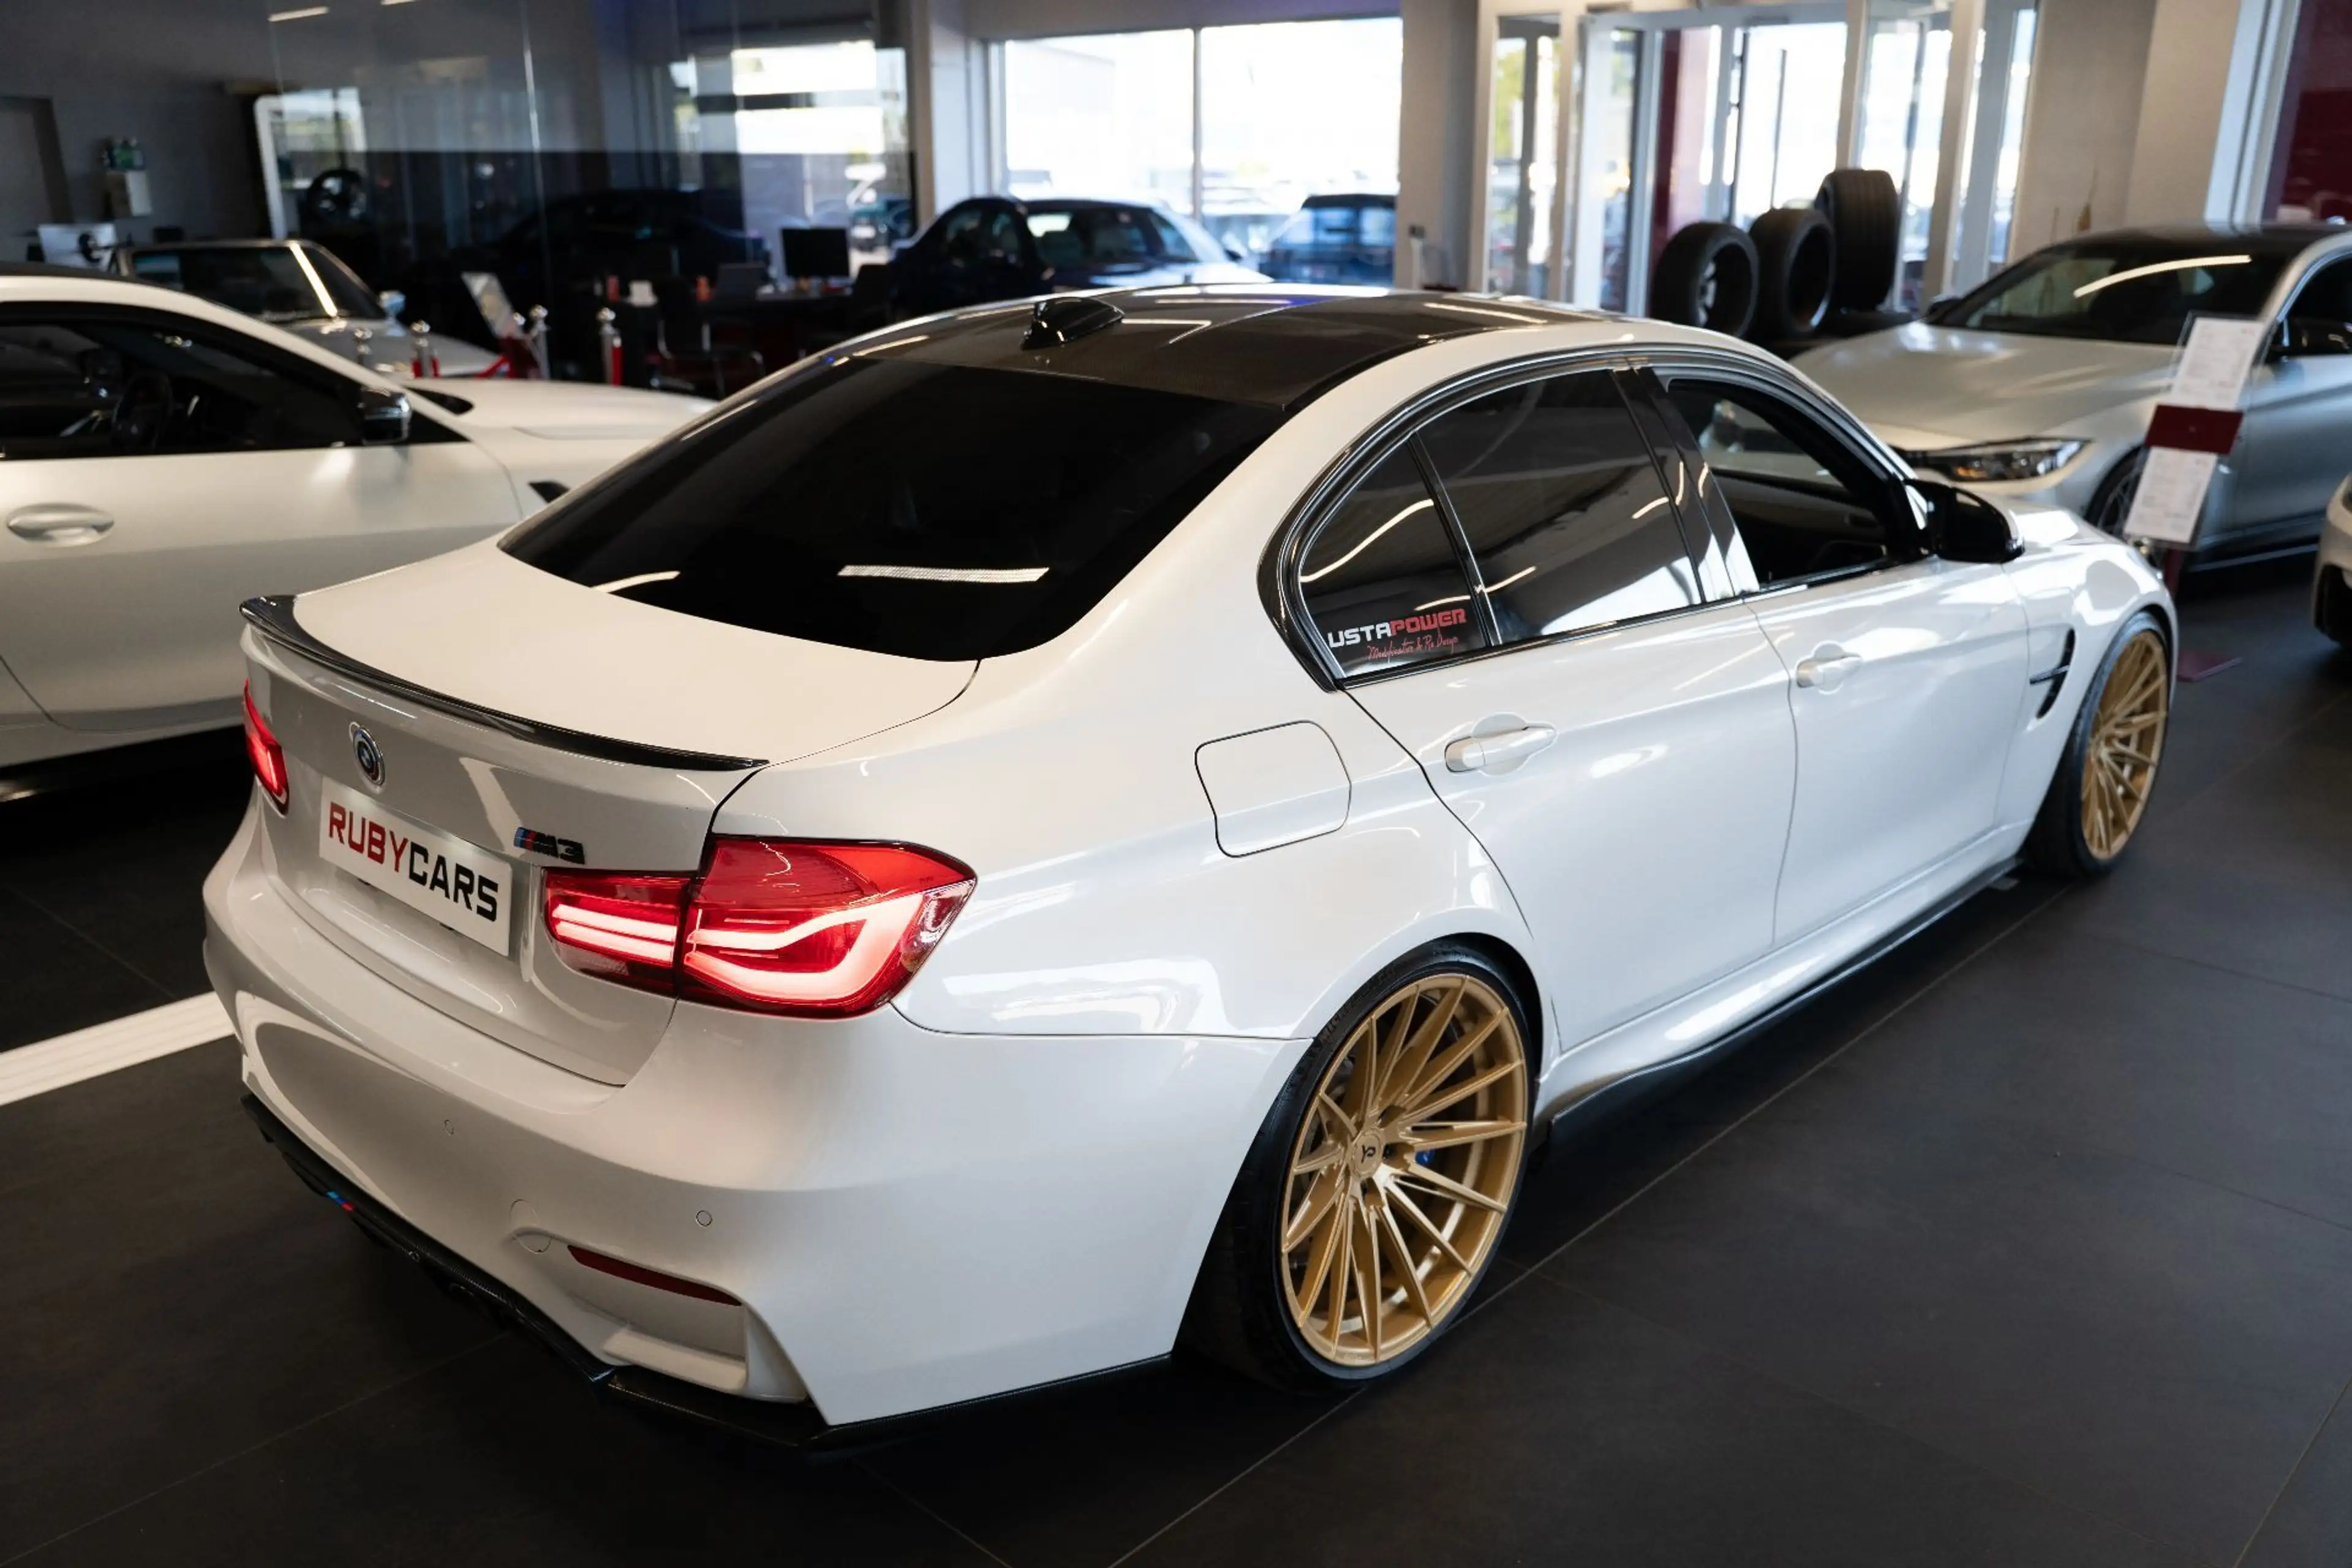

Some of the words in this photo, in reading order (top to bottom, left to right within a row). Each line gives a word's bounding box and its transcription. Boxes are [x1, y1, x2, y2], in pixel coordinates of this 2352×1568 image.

[1327, 608, 1467, 648] USTAPOWER
[329, 801, 499, 922] RUBYCARS
[528, 829, 585, 864] M3
